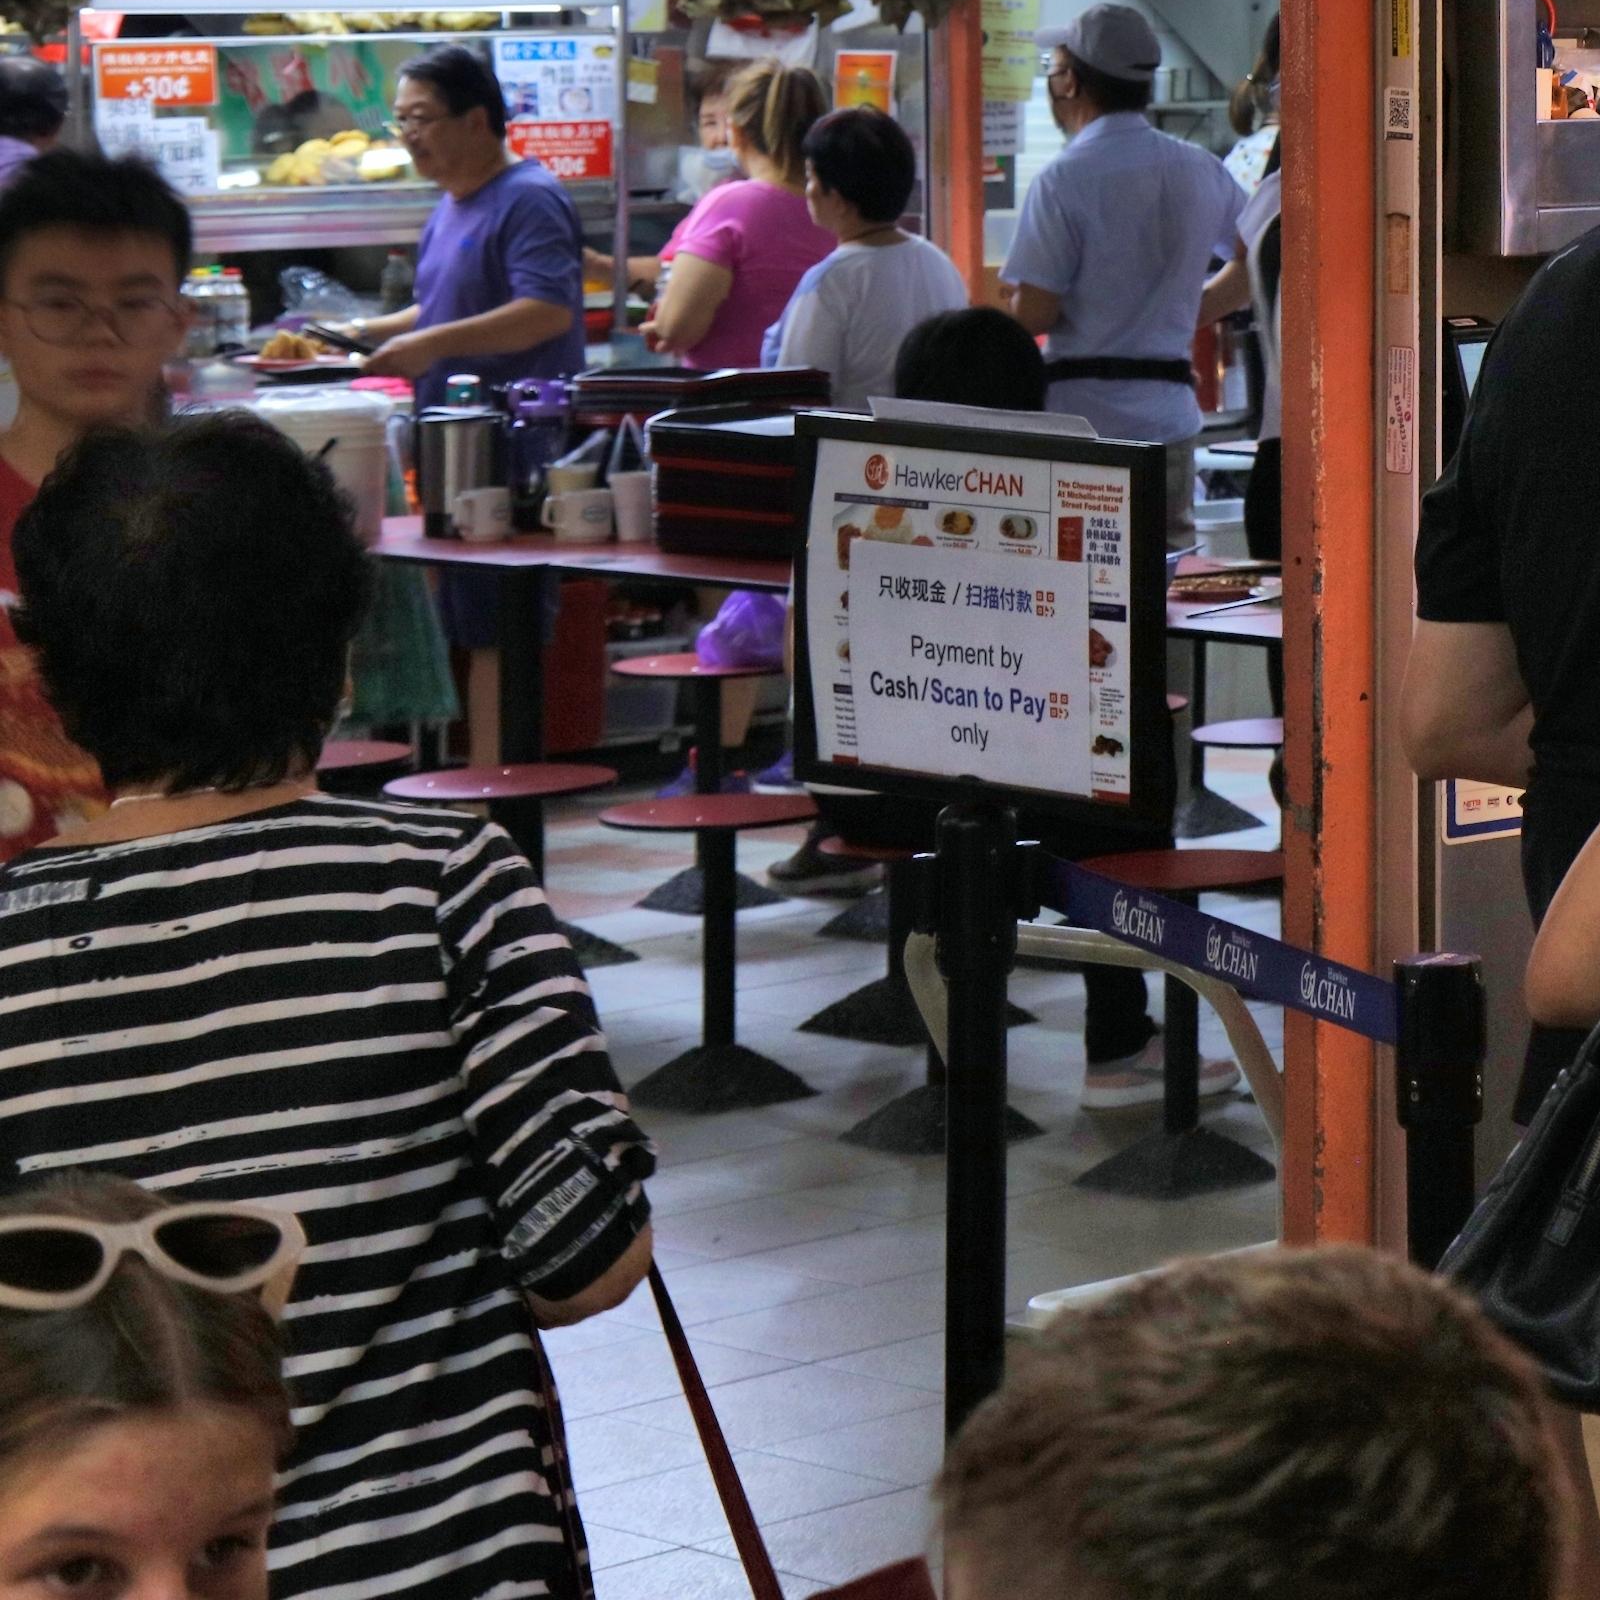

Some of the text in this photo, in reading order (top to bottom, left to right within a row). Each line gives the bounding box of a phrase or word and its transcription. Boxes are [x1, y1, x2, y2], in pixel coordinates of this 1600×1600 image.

[879, 575, 1032, 613] 只收现金 扫描付款
[910, 635, 1023, 675] Payment by
[983, 686, 1003, 711] to
[1010, 688, 1045, 723] Pay
[951, 722, 989, 751] only
[1128, 908, 1165, 946] CHAN
[1221, 944, 1259, 982] CHAN
[1316, 980, 1356, 1021] CHAN
